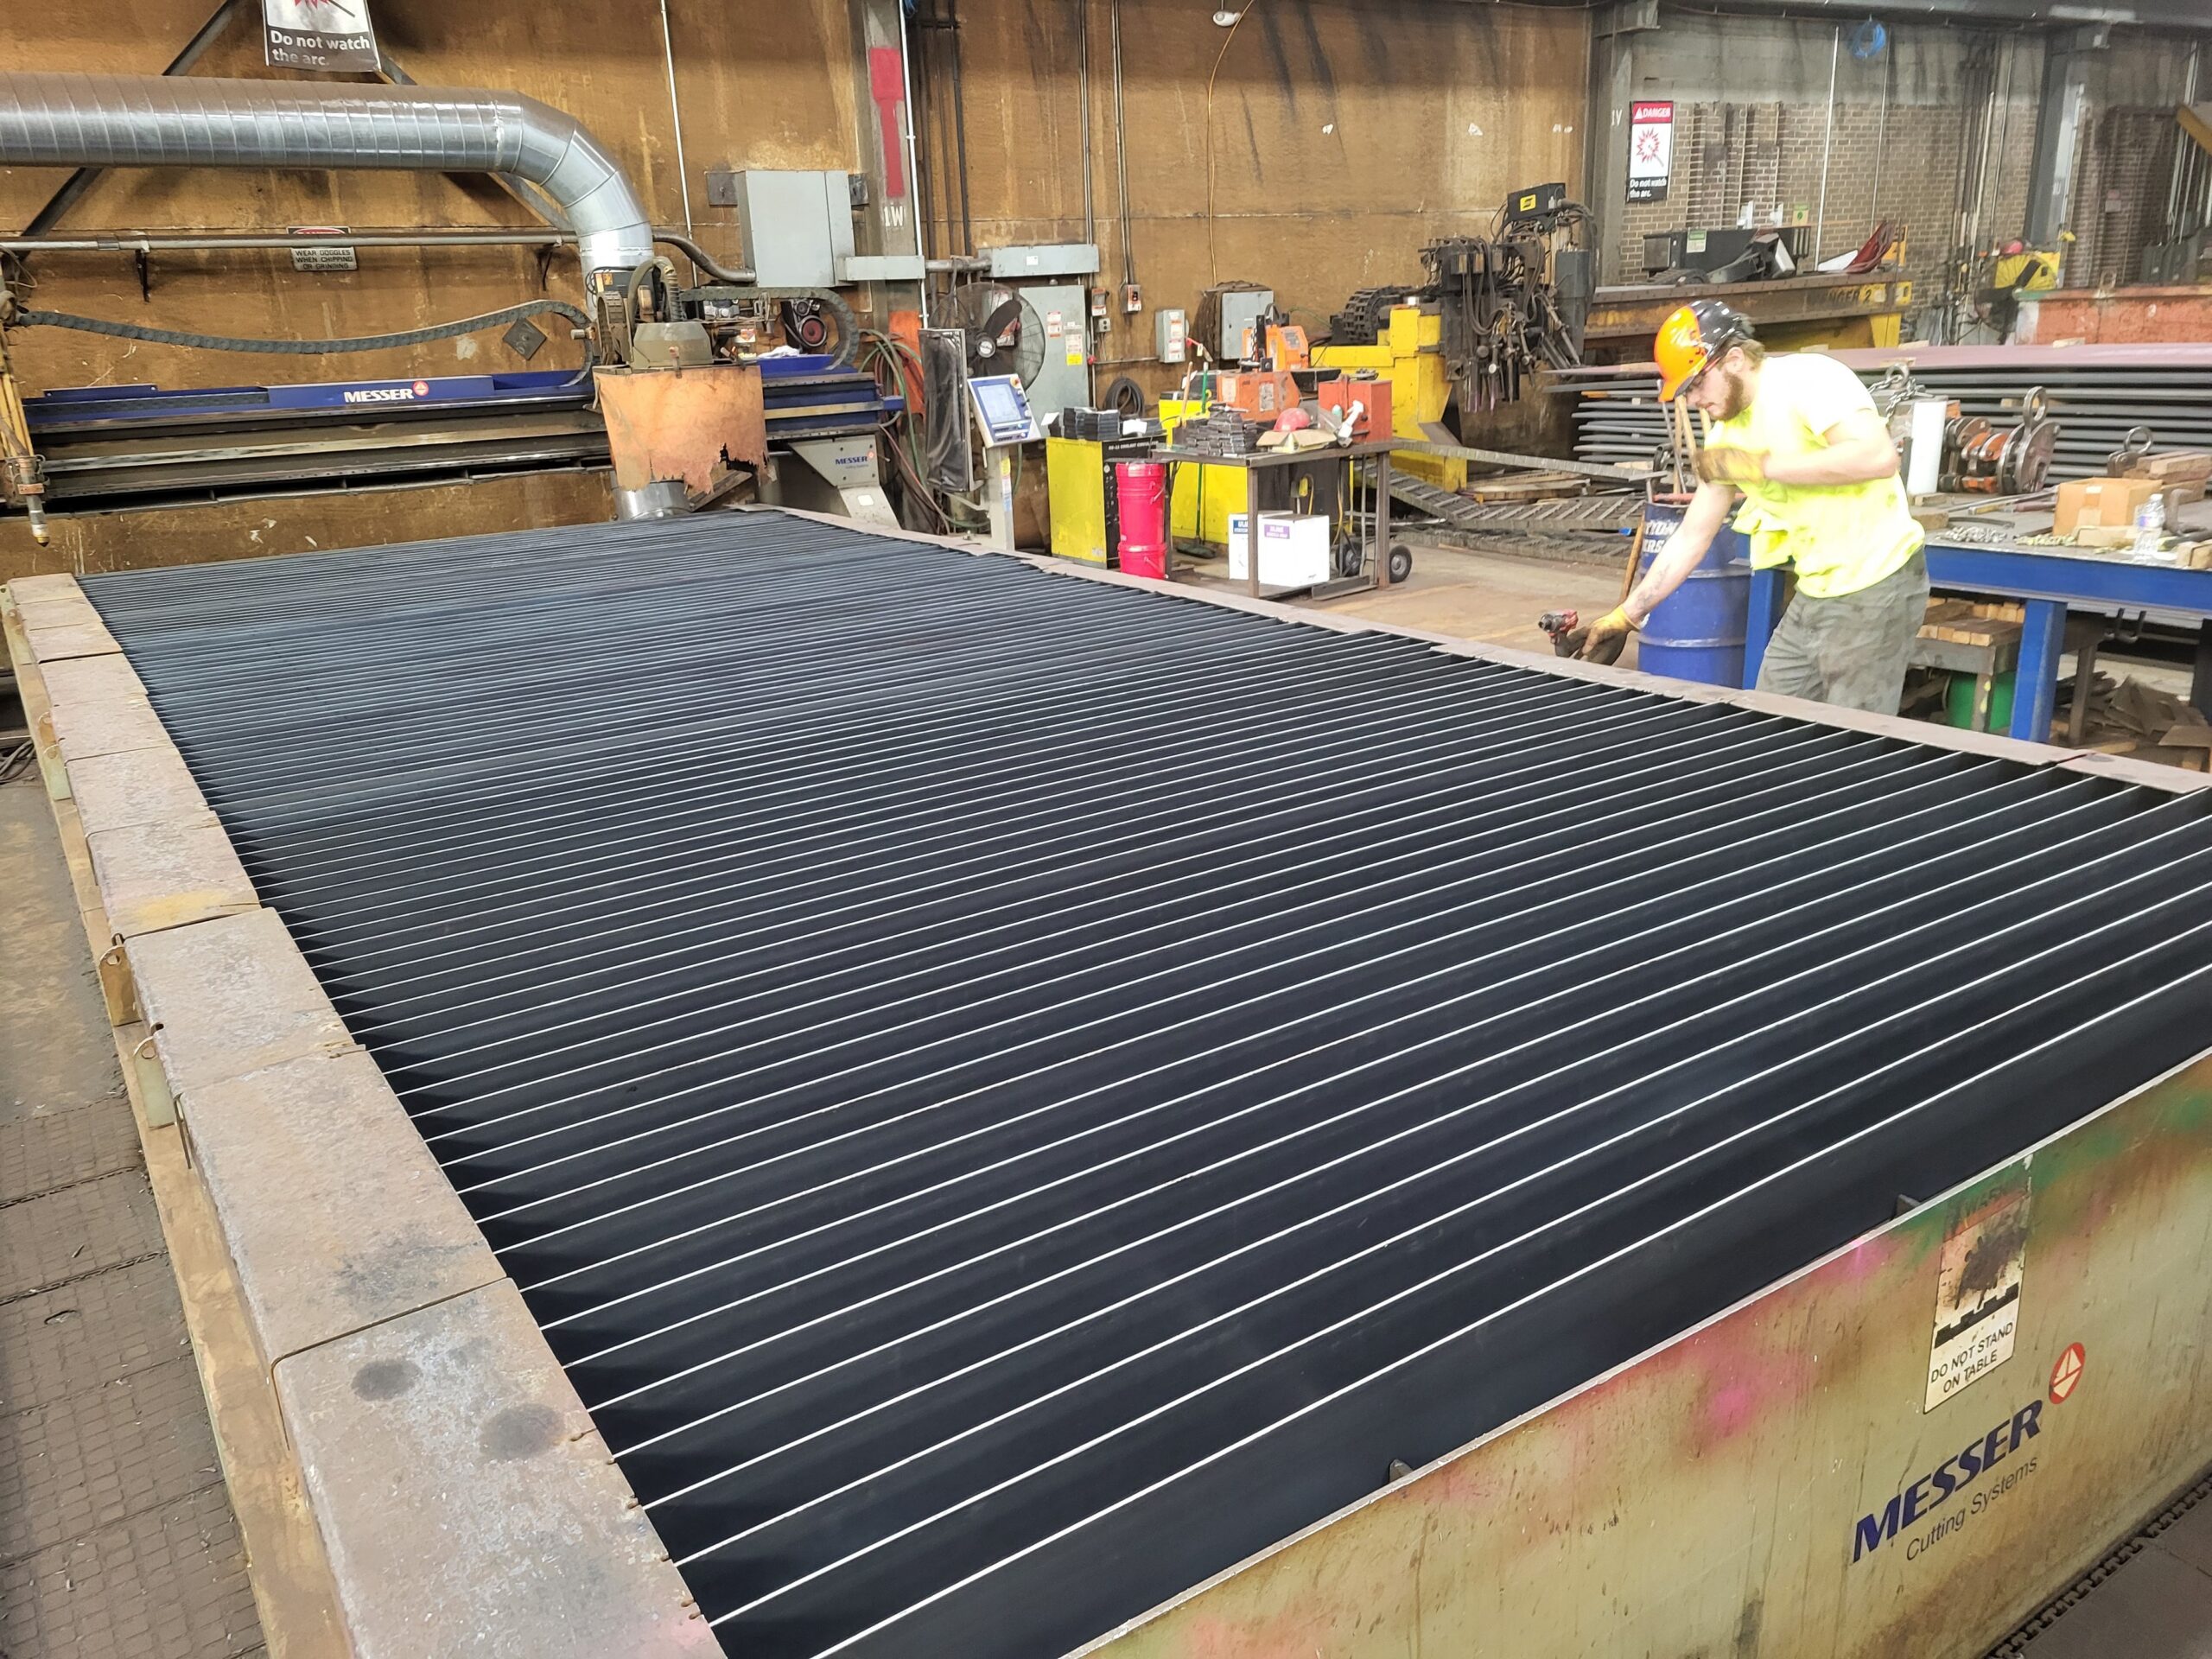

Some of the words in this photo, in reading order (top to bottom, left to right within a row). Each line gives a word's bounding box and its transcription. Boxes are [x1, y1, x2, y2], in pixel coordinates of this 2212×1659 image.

[270, 29, 293, 46] Do
[296, 36, 323, 48] not
[327, 35, 371, 51] watch
[272, 48, 299, 63] the
[1643, 107, 1671, 118] DANGER
[1630, 178, 1639, 188] Do
[1639, 179, 1651, 188] not
[1629, 188, 1640, 199] the
[343, 388, 415, 404] MESSER
[835, 455, 868, 465] MESSER
[1931, 1363, 1948, 1382] DO
[1951, 1345, 1975, 1370] NOT
[1977, 1321, 2013, 1353] STAND
[1943, 1373, 1960, 1393] ON
[1963, 1349, 1998, 1381] TABLE
[1853, 1400, 2043, 1564] MESSER
[1906, 1507, 1966, 1561] Cutting
[1970, 1457, 2038, 1515] Systems
